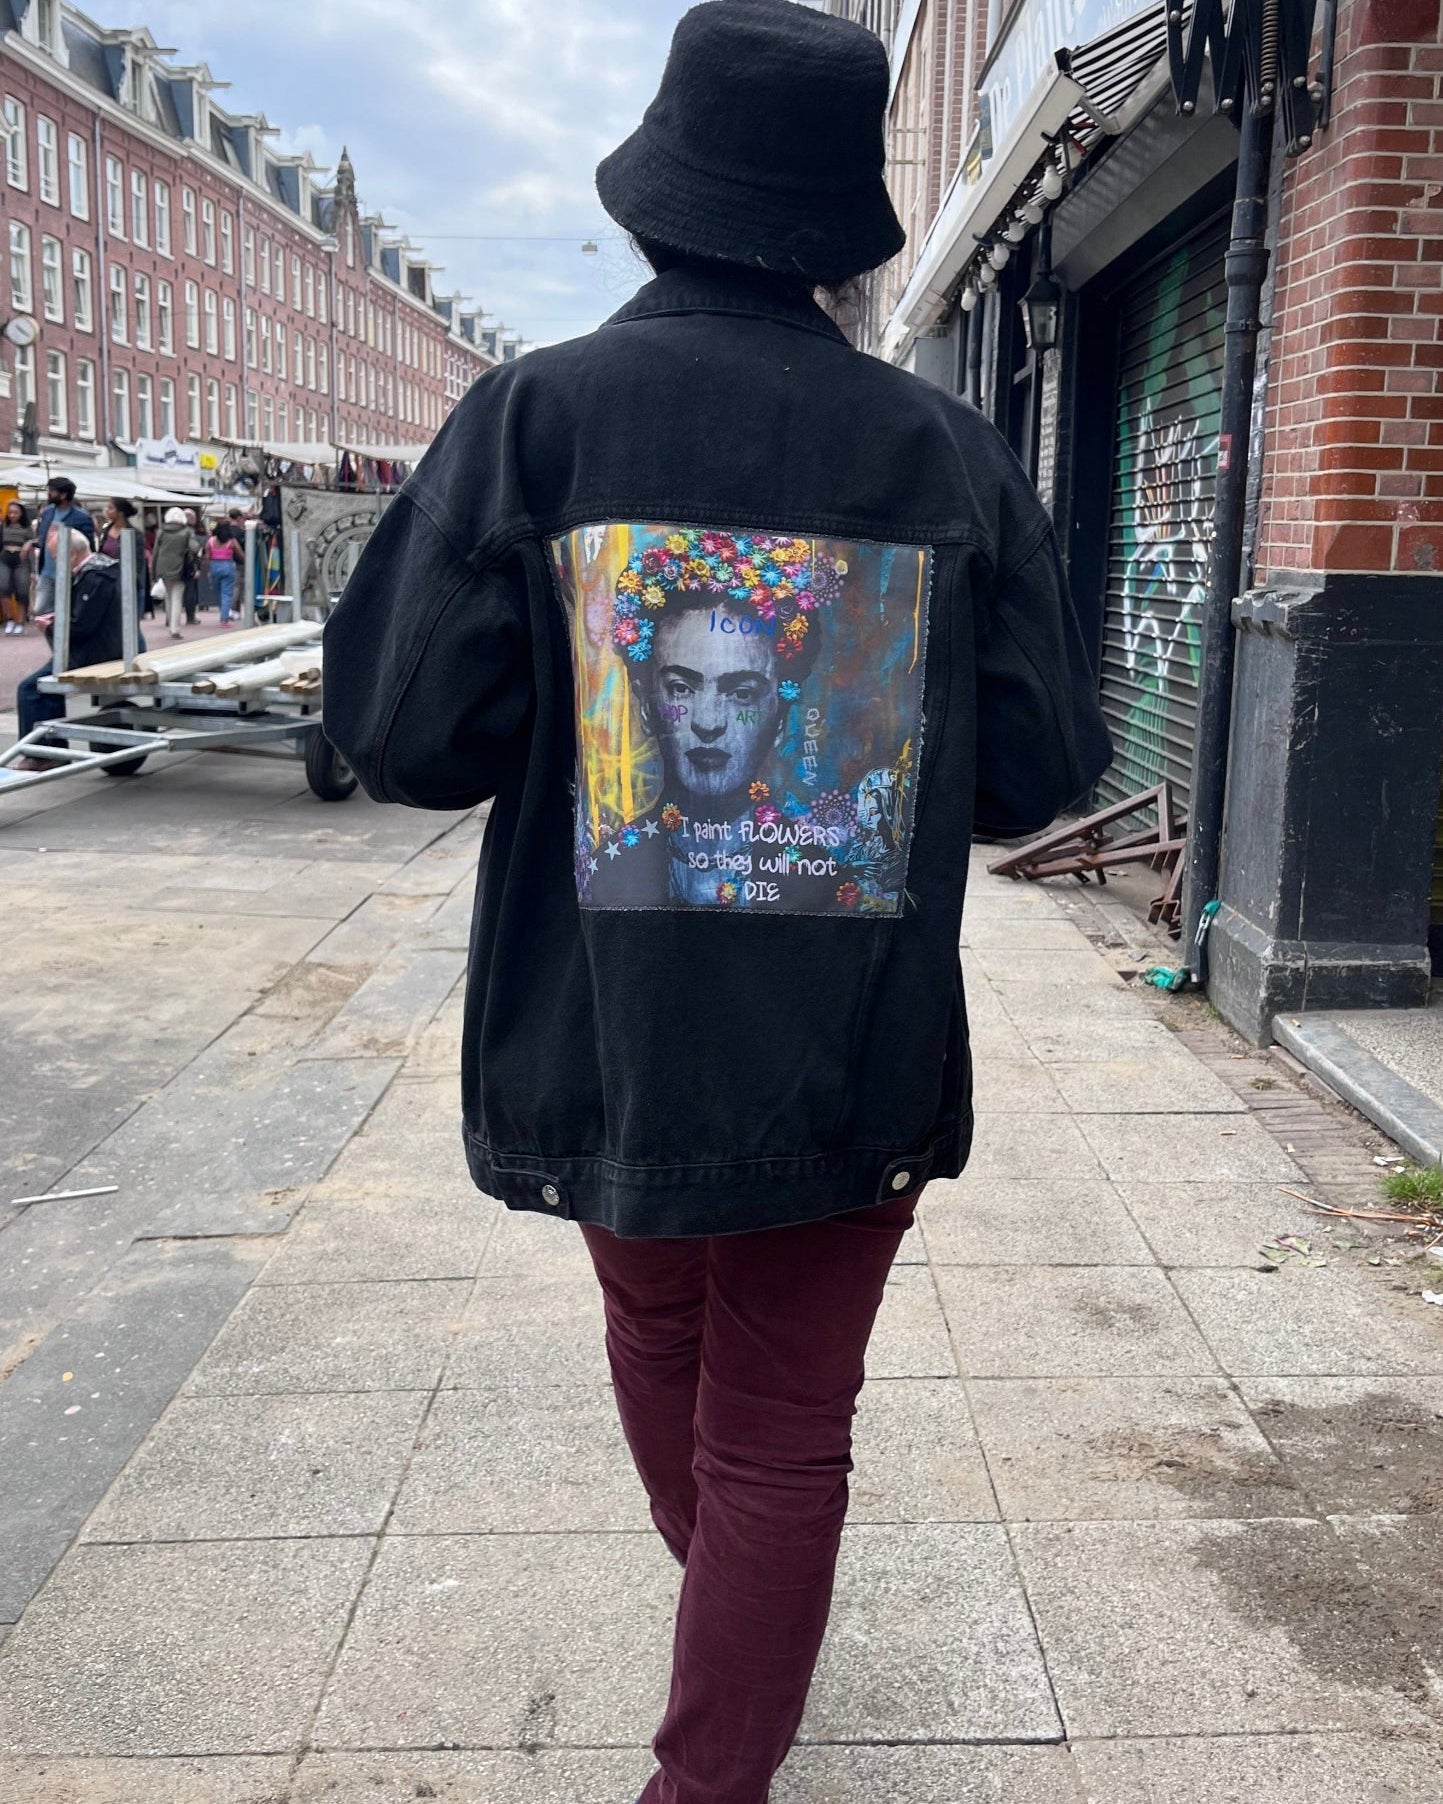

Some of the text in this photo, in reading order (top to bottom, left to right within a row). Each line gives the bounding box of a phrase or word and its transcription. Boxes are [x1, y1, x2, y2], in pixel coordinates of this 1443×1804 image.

[709, 610, 776, 637] ICON
[659, 703, 763, 725] POP ART
[802, 708, 821, 787] QUEEN
[681, 816, 840, 847] I paint FLOWERS
[688, 849, 838, 876] so they will not
[744, 881, 780, 902] DIE
